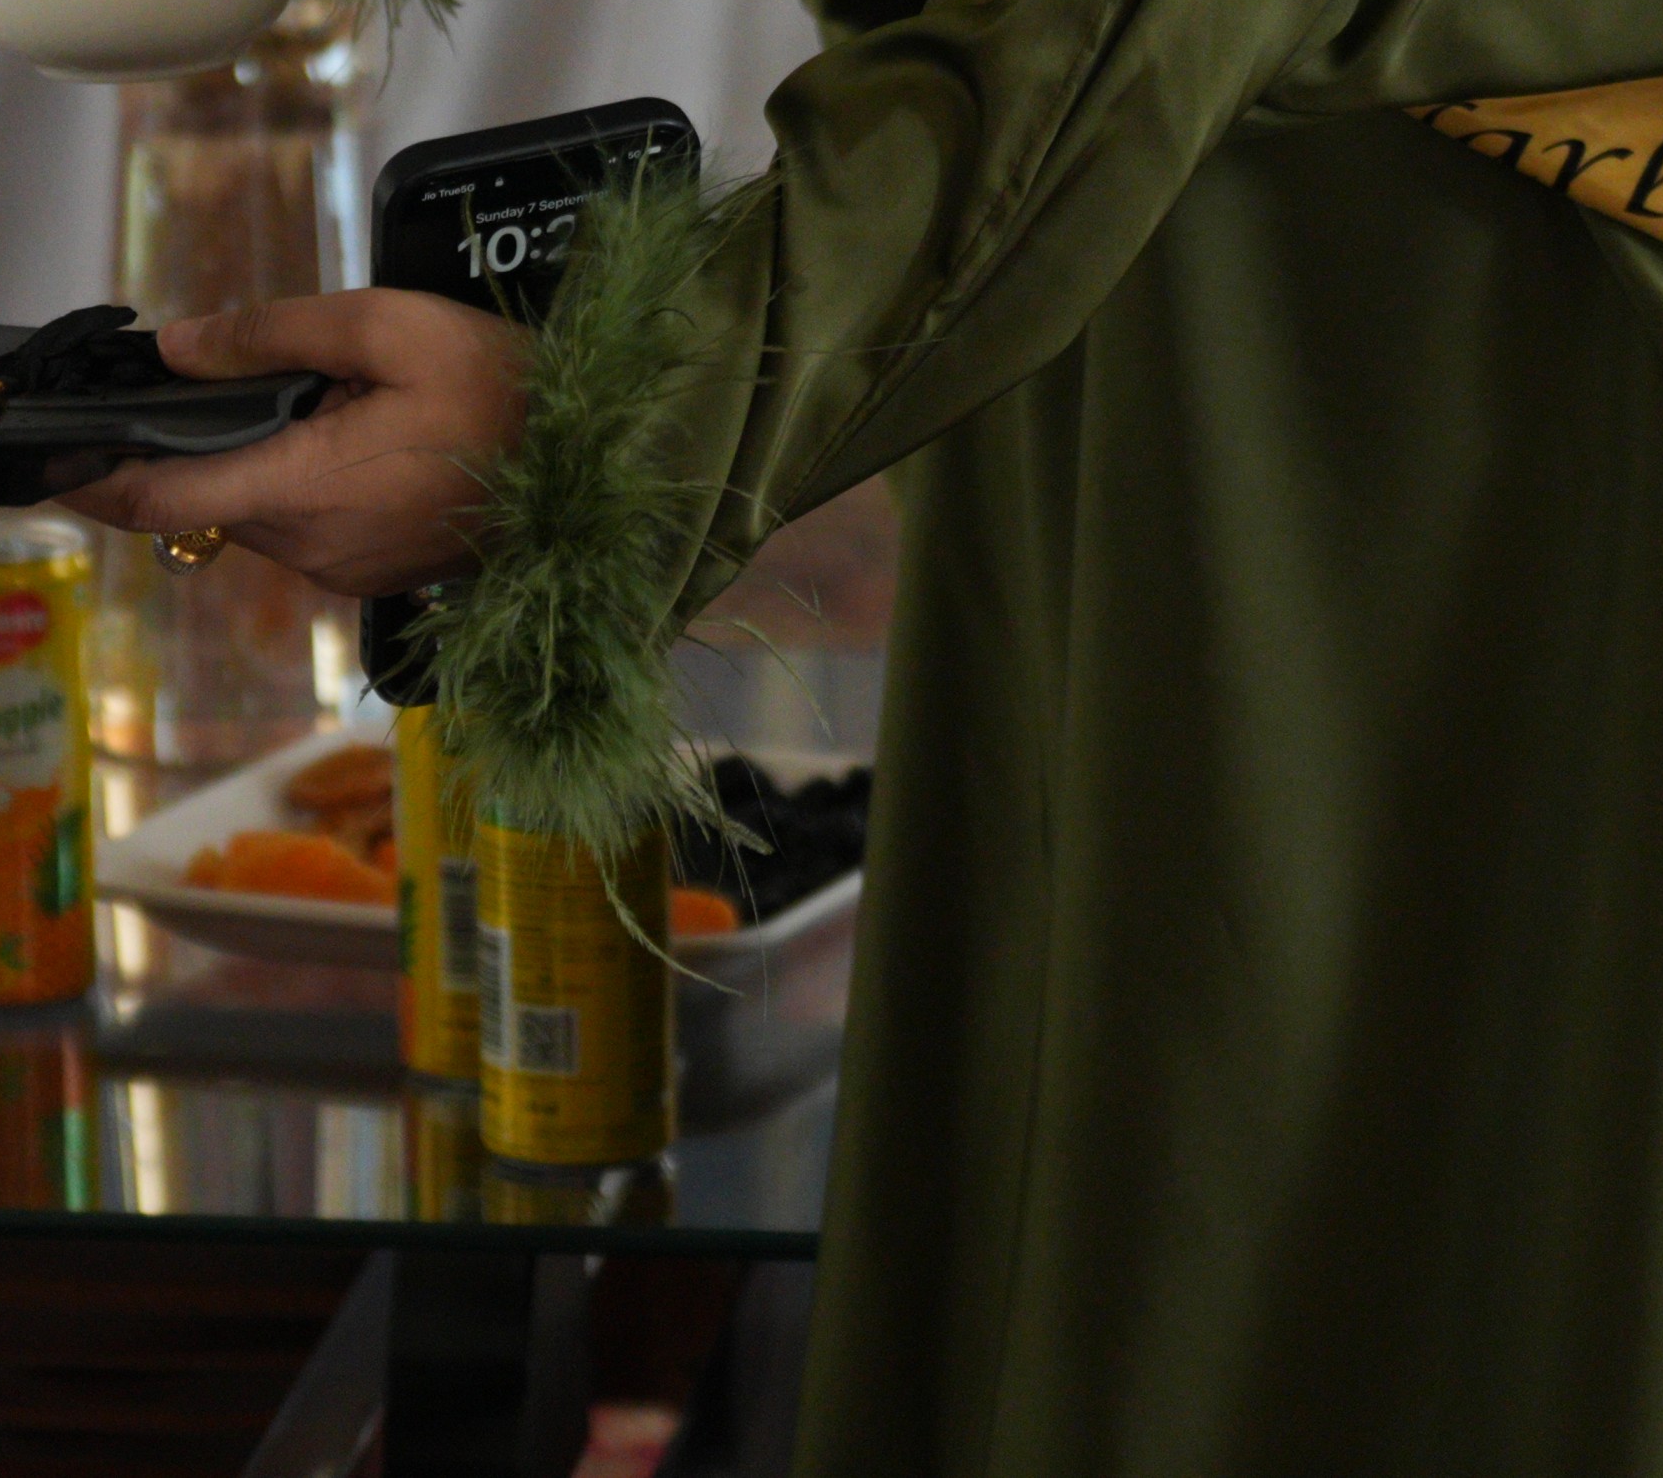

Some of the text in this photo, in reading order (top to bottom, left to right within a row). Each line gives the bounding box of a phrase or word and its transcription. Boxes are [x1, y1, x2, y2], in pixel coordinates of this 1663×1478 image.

[421, 182, 475, 202] Jio True5G
[475, 204, 525, 224] Sunday
[527, 202, 537, 214] 7
[457, 213, 576, 279] 10:2
